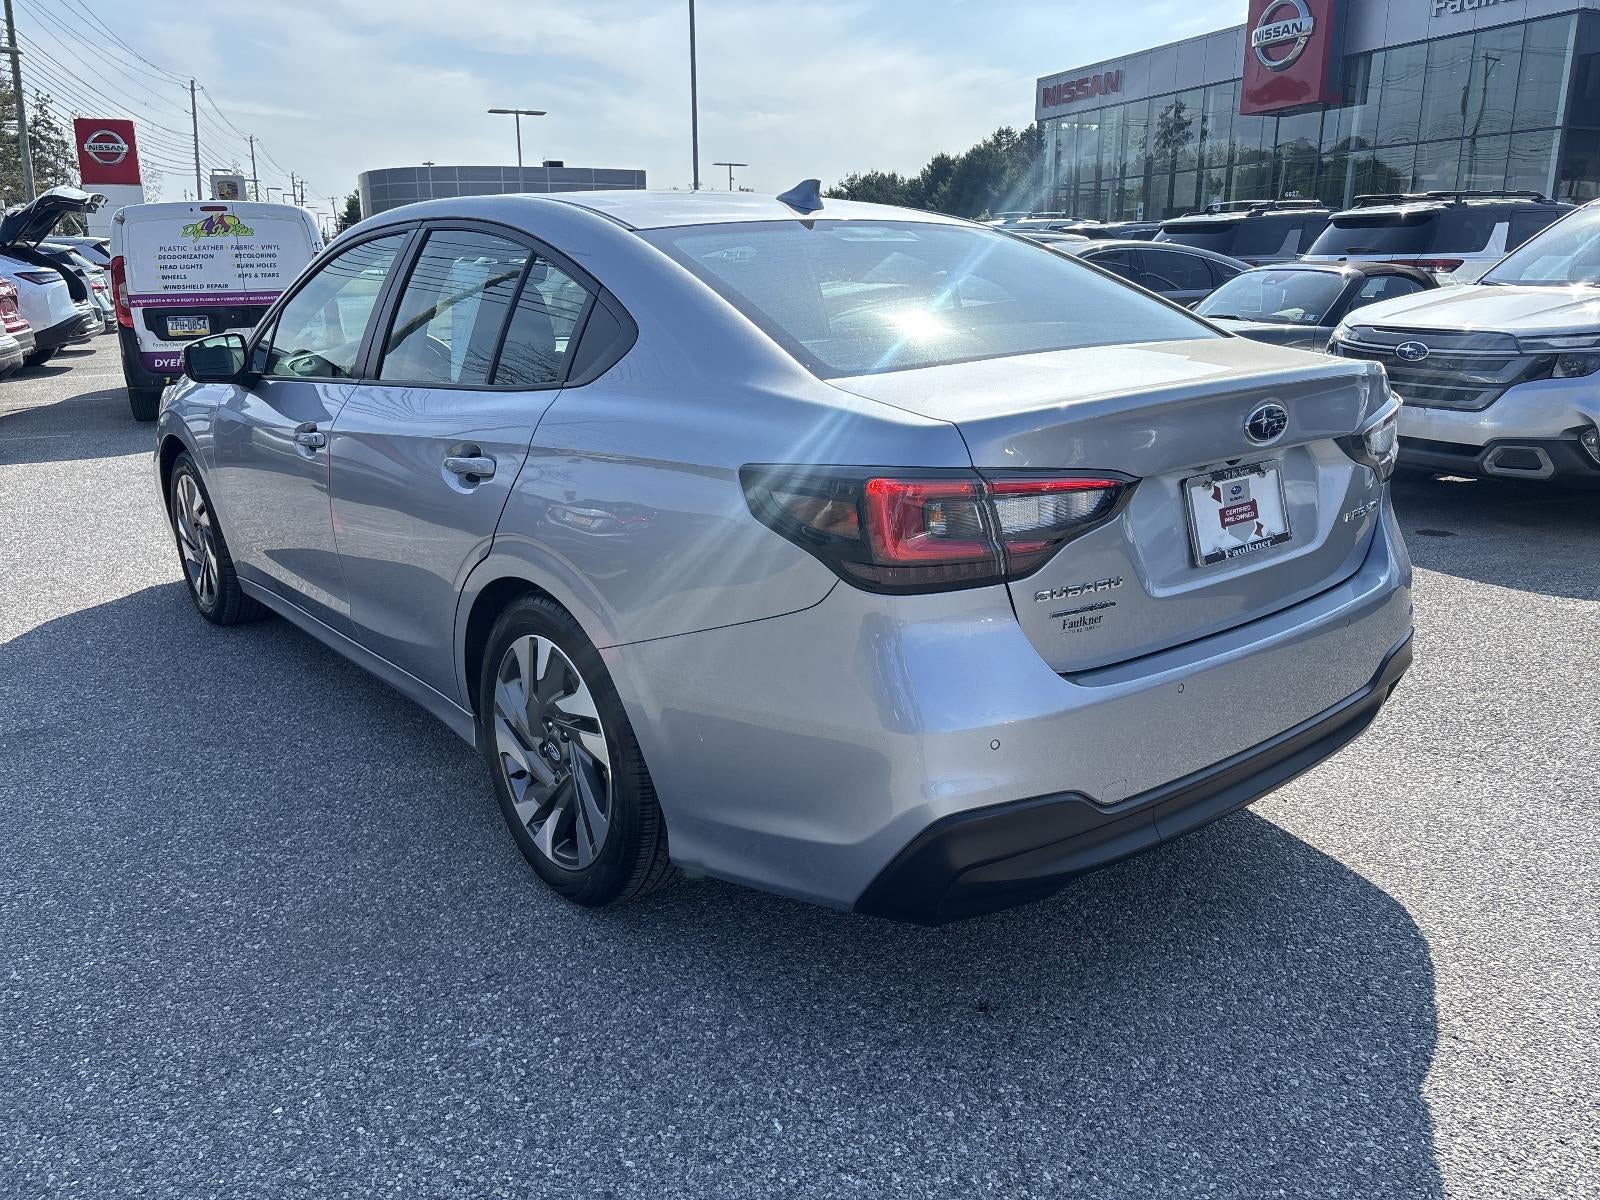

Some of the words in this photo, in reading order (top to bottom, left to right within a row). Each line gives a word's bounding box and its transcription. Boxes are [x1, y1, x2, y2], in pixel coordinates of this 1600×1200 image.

[1430, 0, 1508, 17] Fau
[1254, 21, 1302, 44] NISSAN
[1042, 69, 1120, 108] NISSAN
[193, 244, 224, 252] LEATHER
[1224, 511, 1255, 524] PRE-OWNED
[1225, 504, 1251, 516] CERTIFIED
[1224, 539, 1273, 560] Faulkner
[1034, 577, 1123, 602] SUBARU
[1062, 614, 1104, 630] Faulkner
